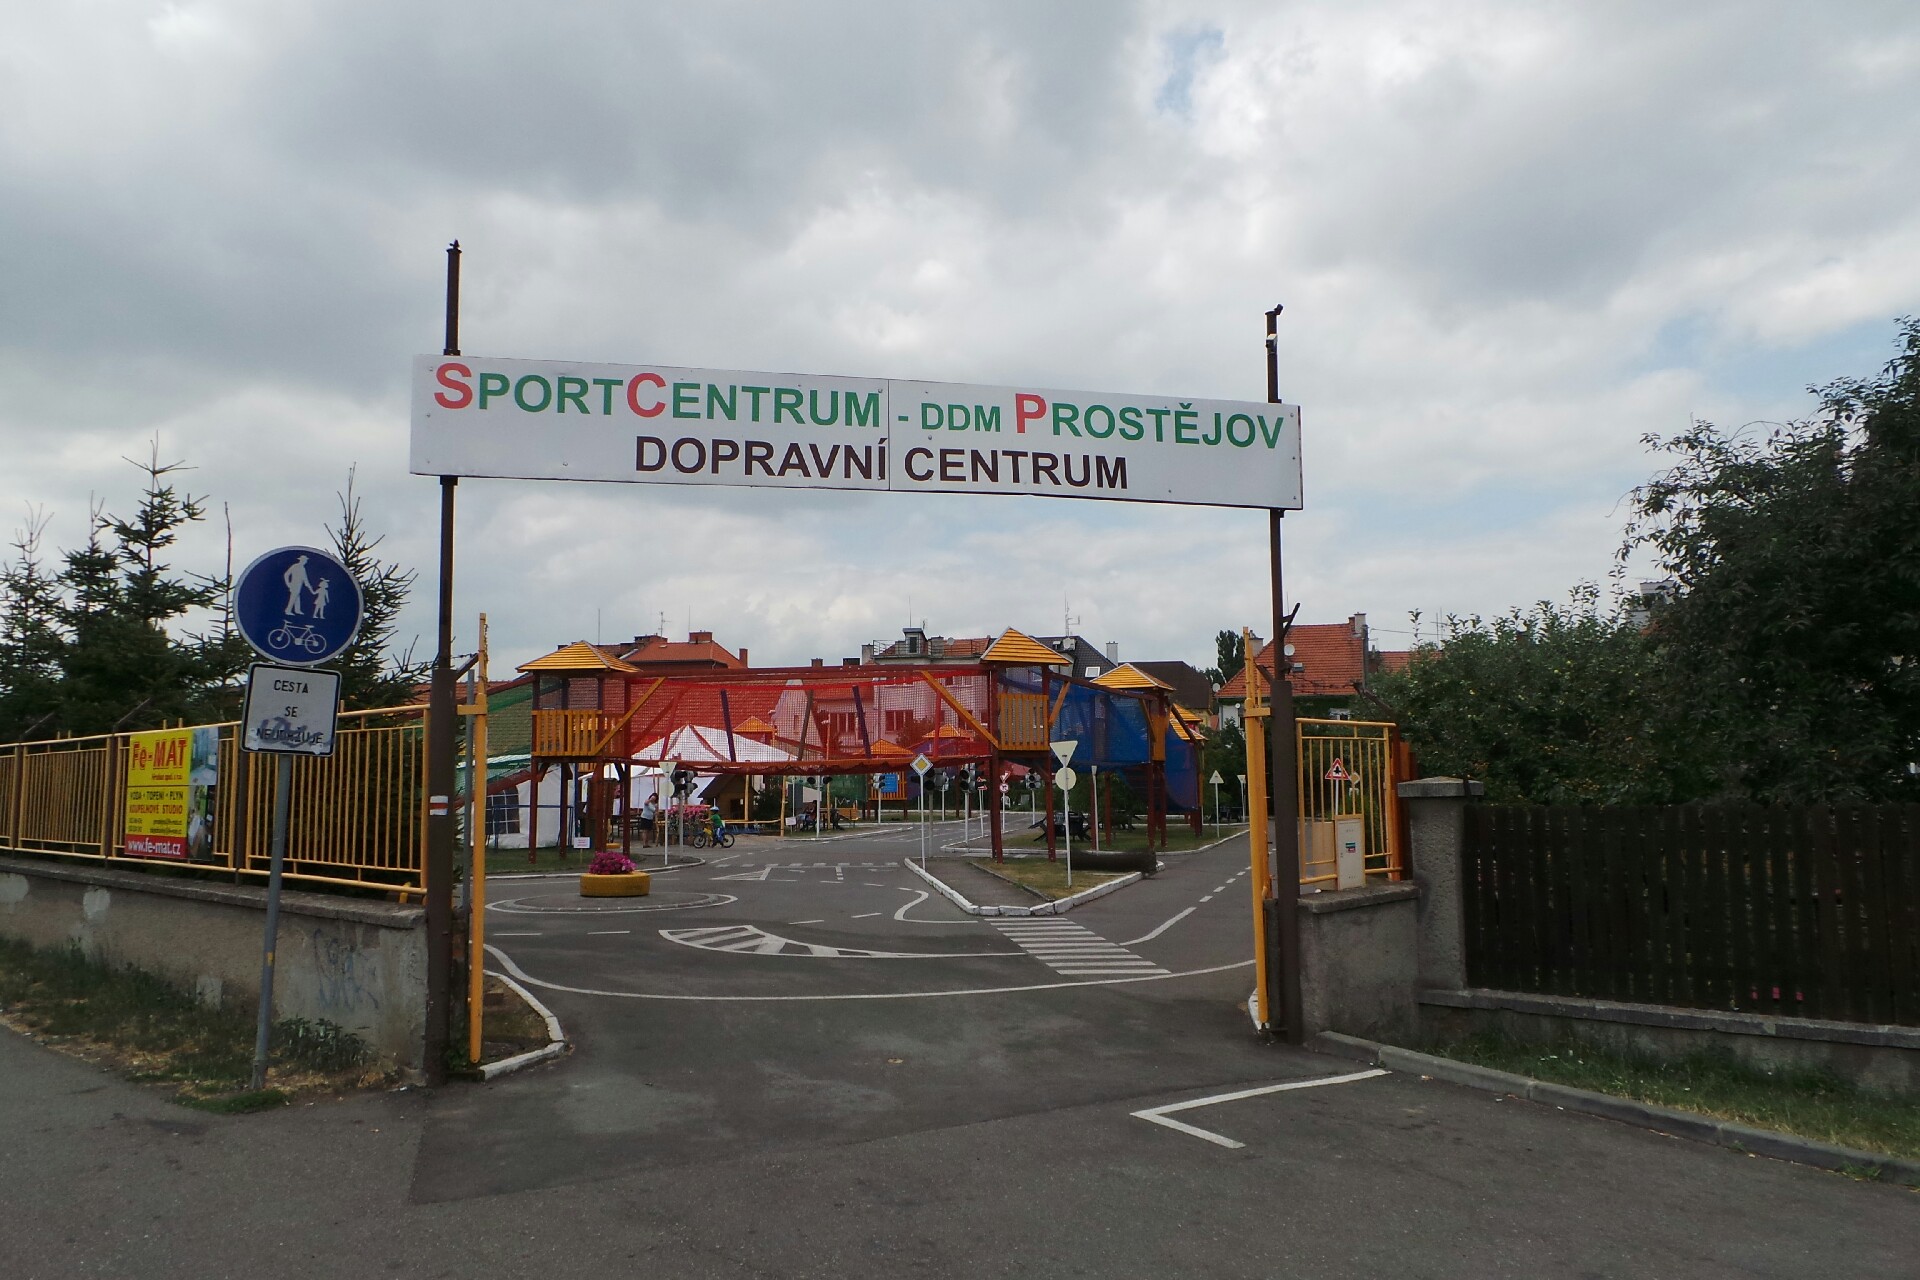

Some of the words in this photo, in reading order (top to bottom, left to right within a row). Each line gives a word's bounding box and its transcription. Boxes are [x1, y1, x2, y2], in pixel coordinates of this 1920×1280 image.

[434, 362, 880, 428] SPORTCENTRUM
[921, 402, 1000, 433] DDM
[1015, 393, 1284, 449] PROSTĚJOV
[635, 436, 887, 481] DOPRAVNÍ
[904, 447, 1128, 490] CENTRUM
[273, 679, 309, 694] CESTA
[284, 705, 298, 718] SE
[131, 737, 188, 770] Fe-MAT
[162, 804, 183, 815] STUDIO
[127, 837, 181, 855] www.fe-mat.cz
